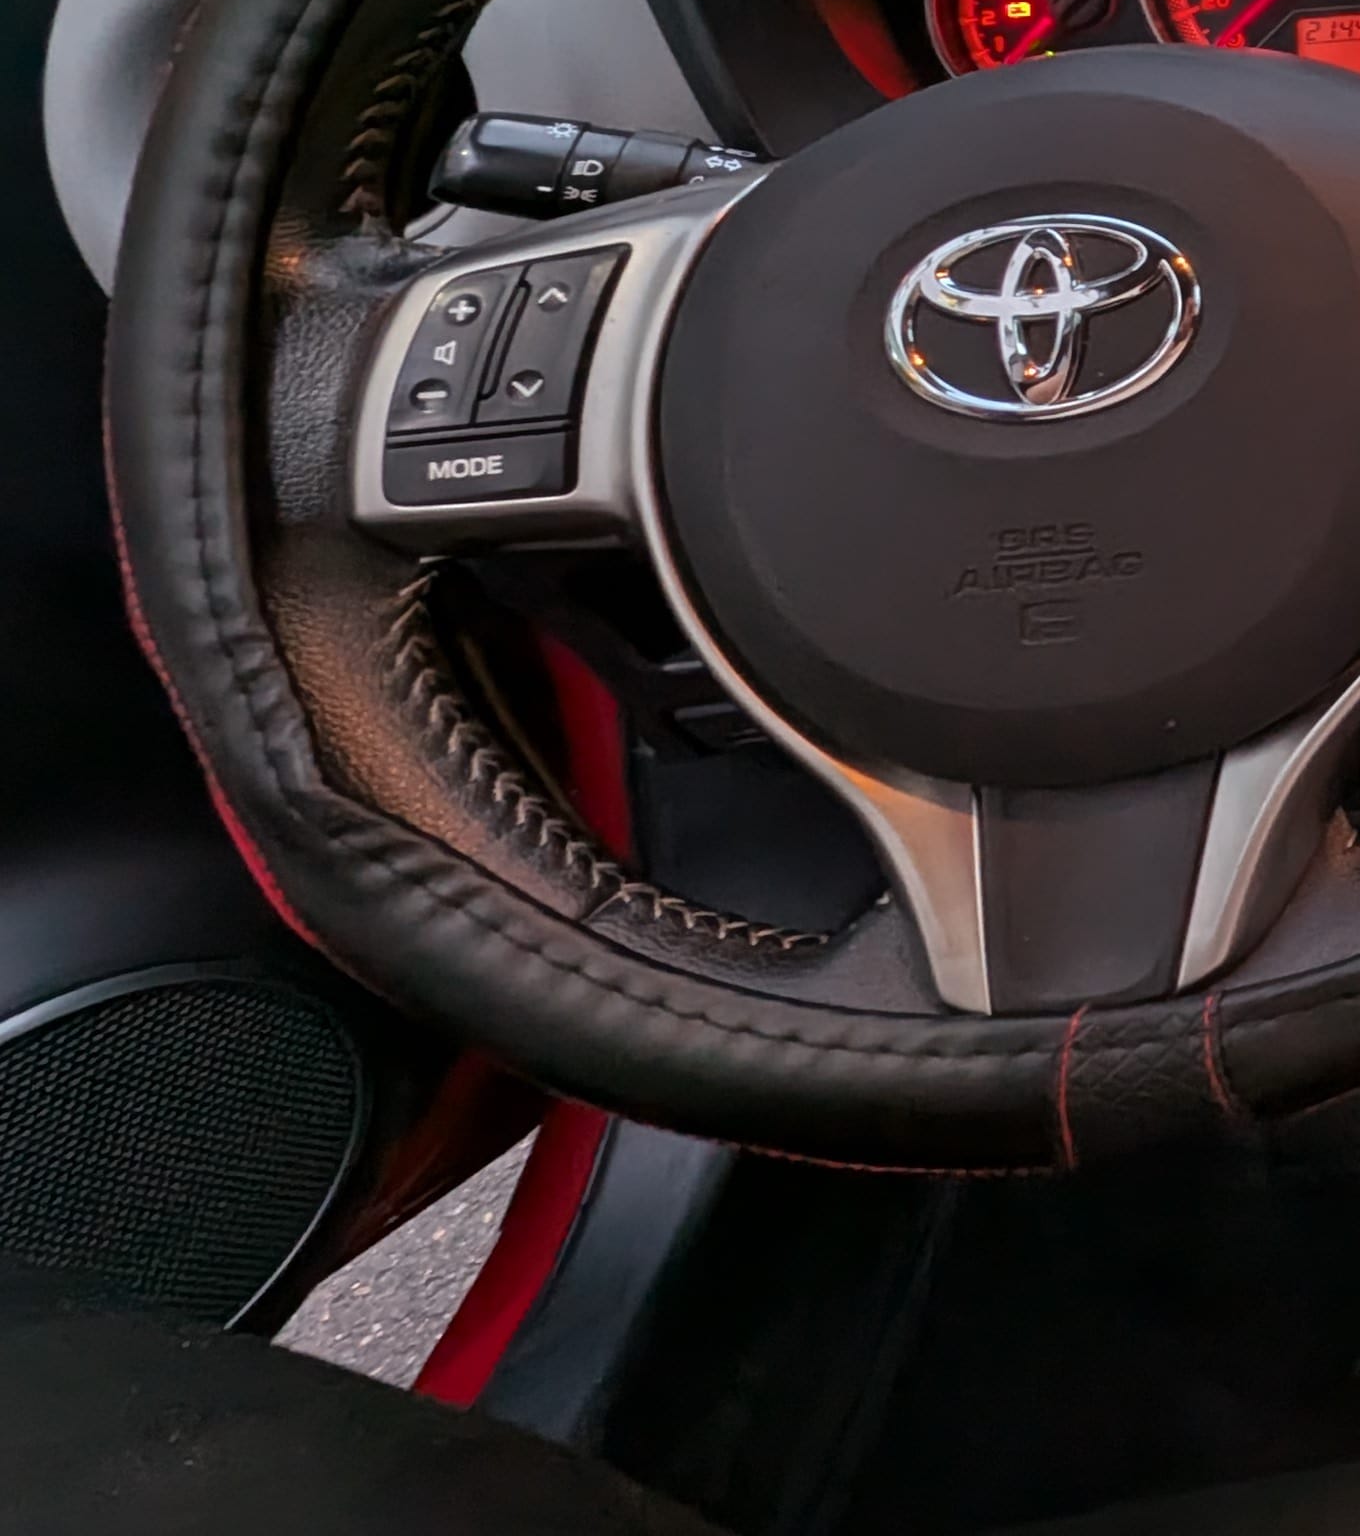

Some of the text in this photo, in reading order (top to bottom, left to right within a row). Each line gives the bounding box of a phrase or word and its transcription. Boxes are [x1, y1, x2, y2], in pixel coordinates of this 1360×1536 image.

[981, 9, 996, 26] 2
[428, 455, 504, 480] MODE
[950, 551, 1144, 597] AIRBAG
